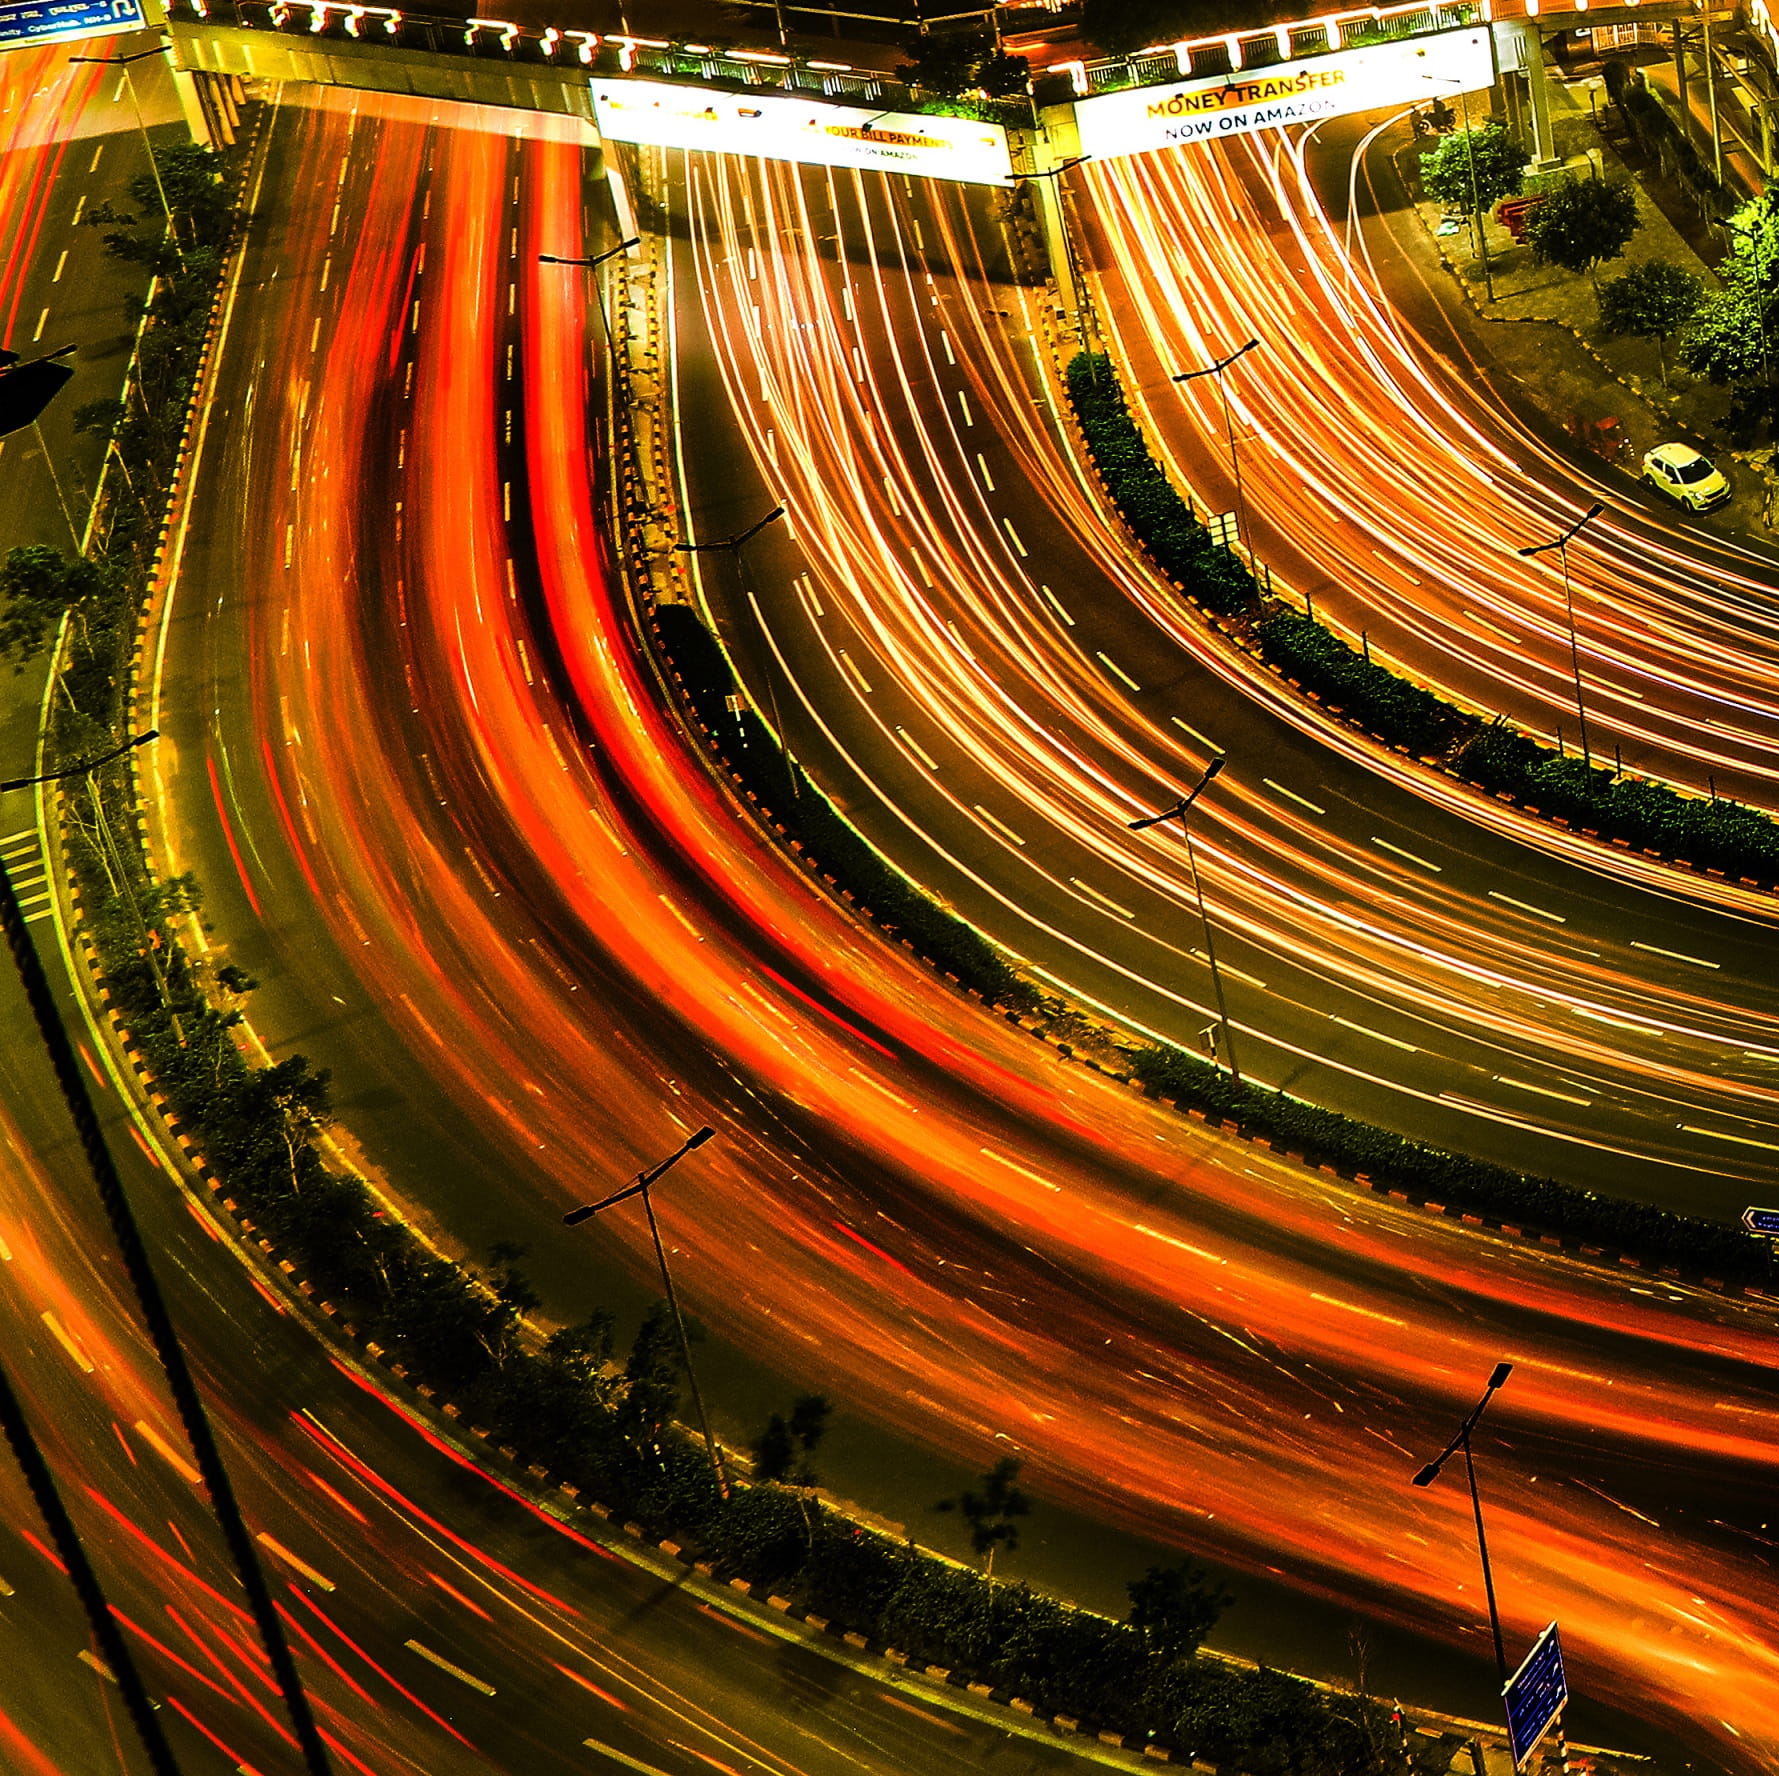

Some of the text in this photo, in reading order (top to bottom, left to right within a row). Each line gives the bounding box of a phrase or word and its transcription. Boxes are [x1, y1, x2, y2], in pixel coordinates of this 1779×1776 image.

[1146, 70, 1346, 119] MONEY TRANSFER
[861, 130, 887, 142] BILL
[1166, 100, 1336, 140] NOW ON AMAZON
